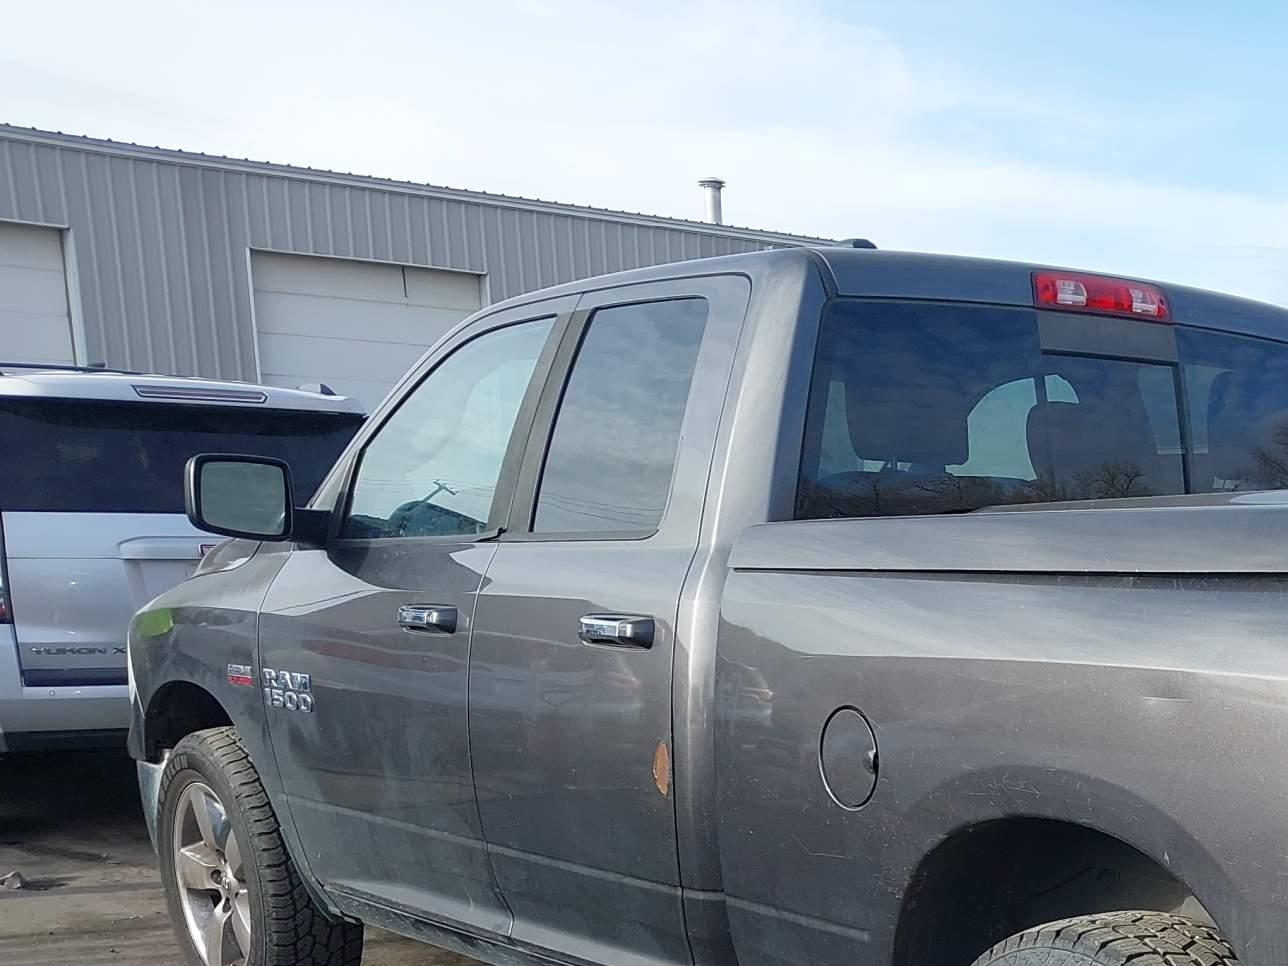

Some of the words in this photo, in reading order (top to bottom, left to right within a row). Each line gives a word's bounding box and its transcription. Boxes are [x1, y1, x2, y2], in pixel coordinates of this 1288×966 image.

[31, 646, 107, 655] YUKON
[263, 667, 311, 692] RAM
[263, 688, 314, 713] 1500
